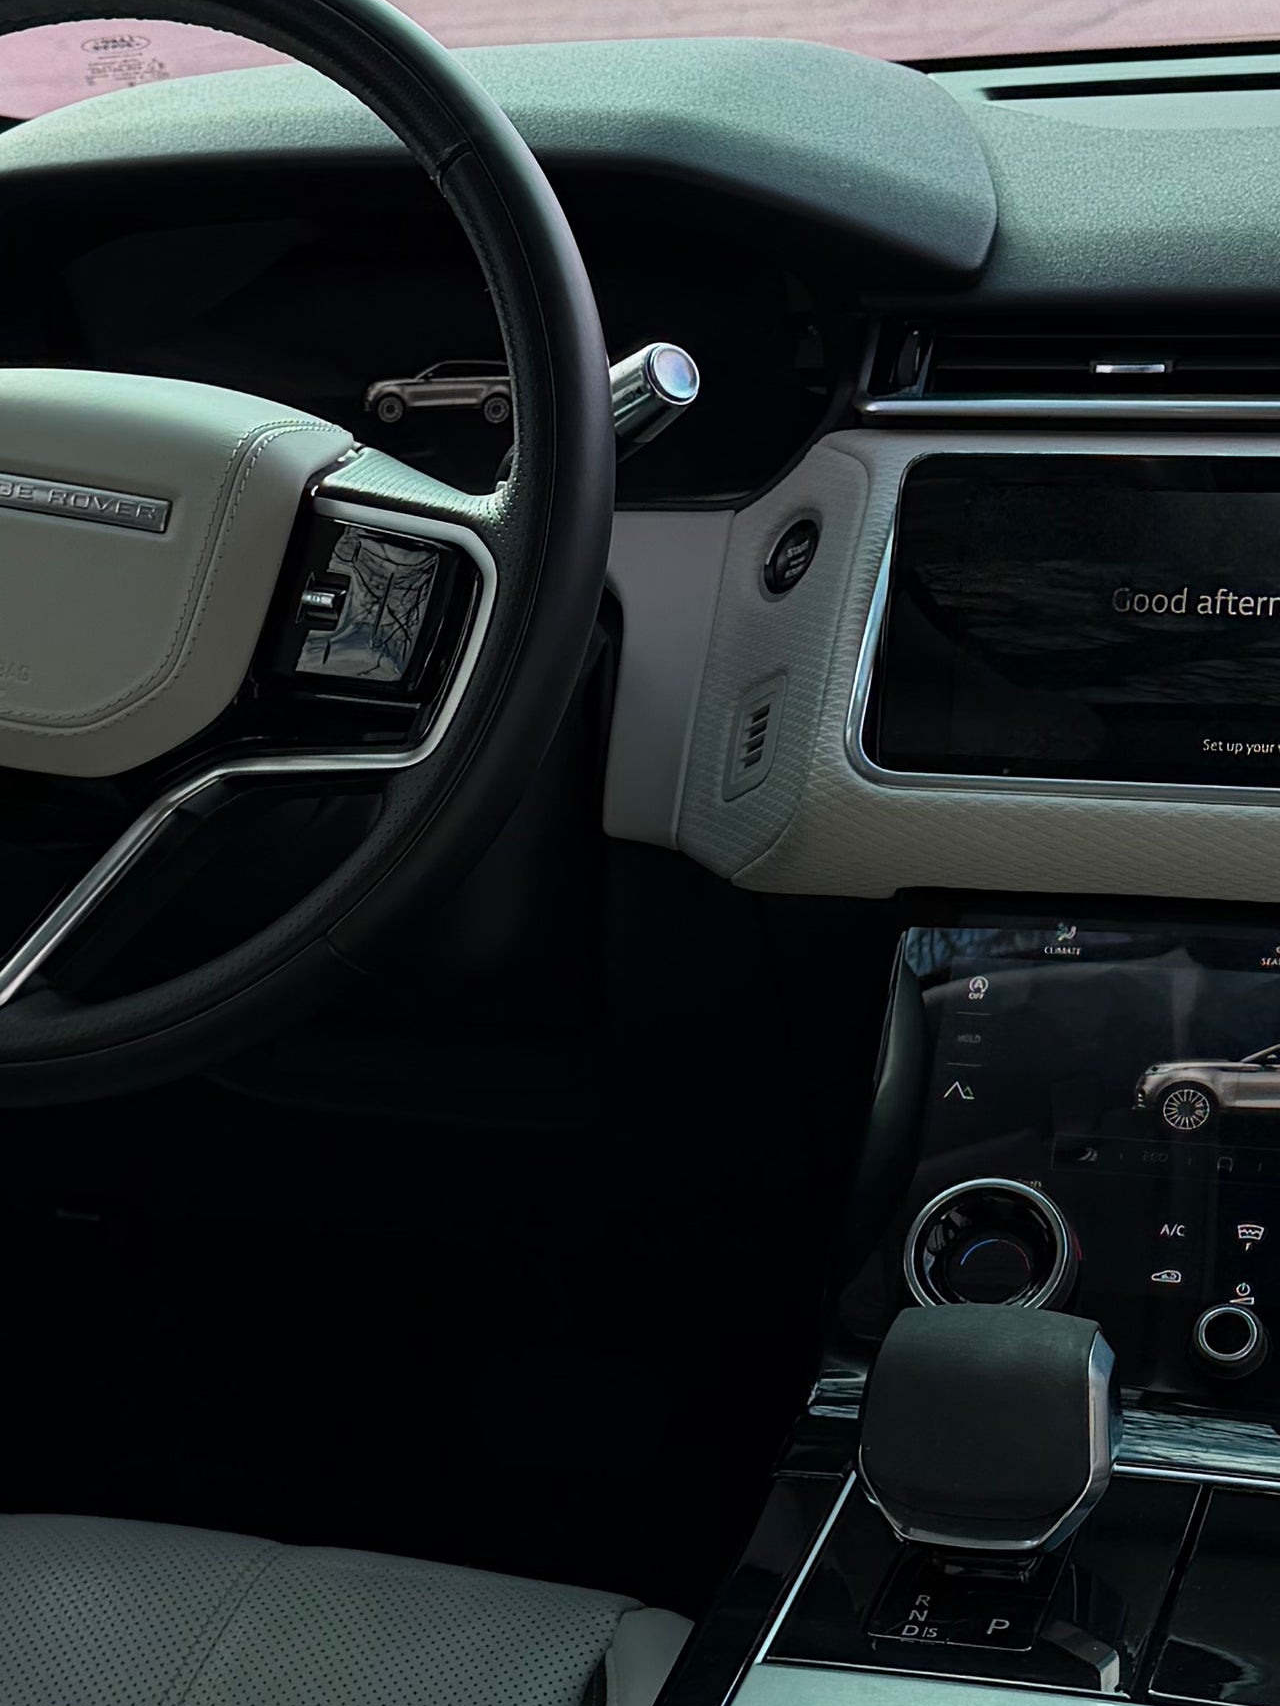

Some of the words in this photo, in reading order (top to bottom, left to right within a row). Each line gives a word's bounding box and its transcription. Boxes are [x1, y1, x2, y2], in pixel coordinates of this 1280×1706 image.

[46, 488, 158, 521] ROVER
[1112, 587, 1188, 613] Good
[1202, 738, 1224, 752] Set
[1226, 742, 1244, 755] up
[1246, 743, 1275, 756] your
[1043, 945, 1082, 957] CLIMATE
[1159, 1223, 1186, 1237] A/C
[914, 1594, 931, 1608] R
[908, 1609, 929, 1622] N
[986, 1618, 1010, 1635] P
